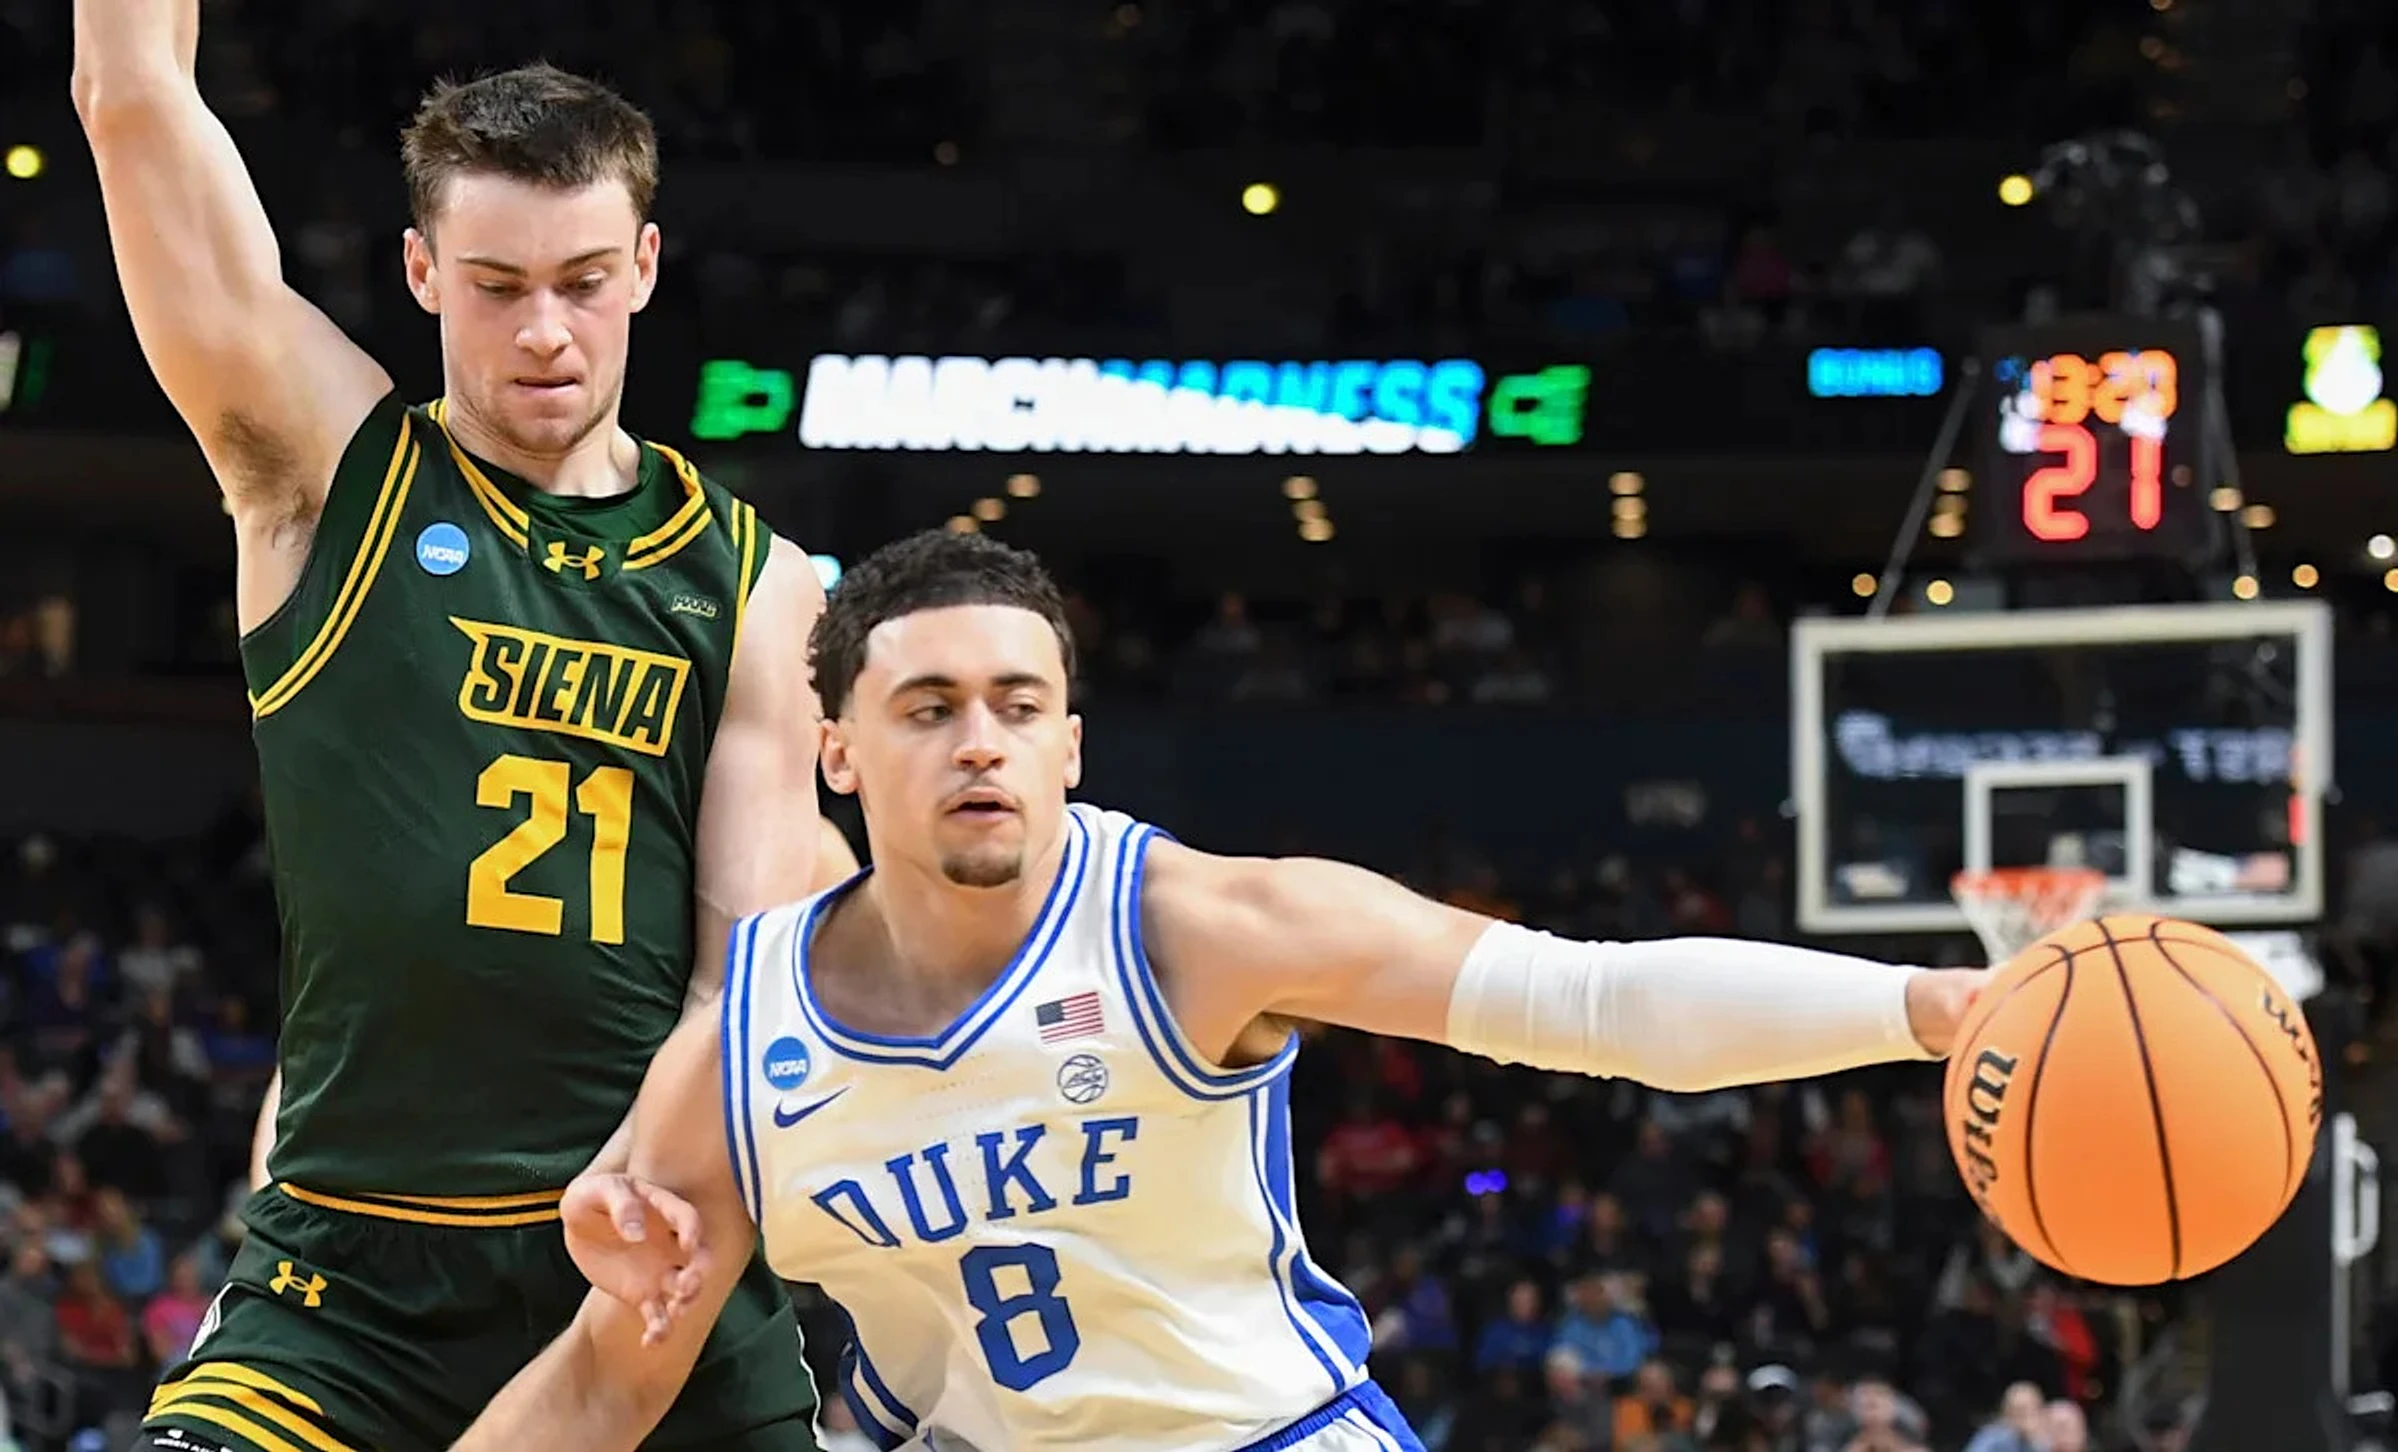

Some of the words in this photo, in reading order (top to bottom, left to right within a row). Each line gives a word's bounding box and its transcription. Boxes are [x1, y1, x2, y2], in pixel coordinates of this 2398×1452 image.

[2024, 424, 2161, 540] 21
[421, 544, 466, 566] NCAA
[470, 632, 678, 745] SIENA
[467, 753, 635, 945] 21
[769, 1059, 807, 1079] NCAA
[810, 1116, 1139, 1248] DUKE
[959, 1242, 1081, 1393] 8
